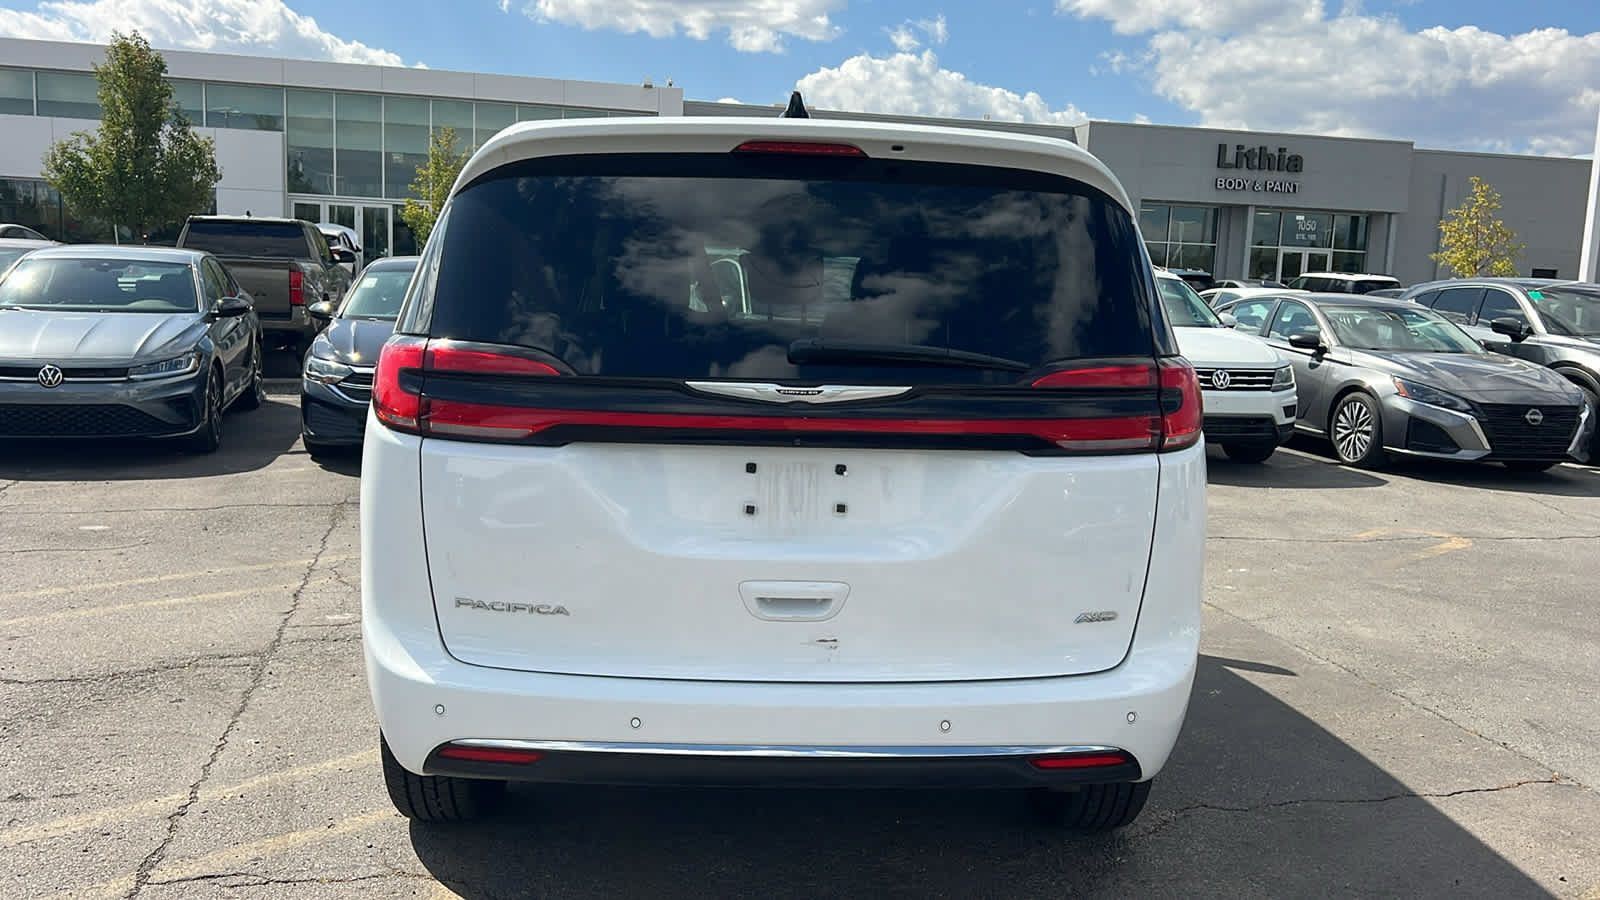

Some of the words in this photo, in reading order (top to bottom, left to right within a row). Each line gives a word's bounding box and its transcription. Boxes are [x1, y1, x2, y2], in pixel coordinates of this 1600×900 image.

[1217, 143, 1304, 172] Lithia
[1216, 178, 1250, 191] BODY
[1254, 181, 1262, 192] &
[1266, 180, 1300, 194] PAINT
[454, 597, 571, 616] PACIFICA
